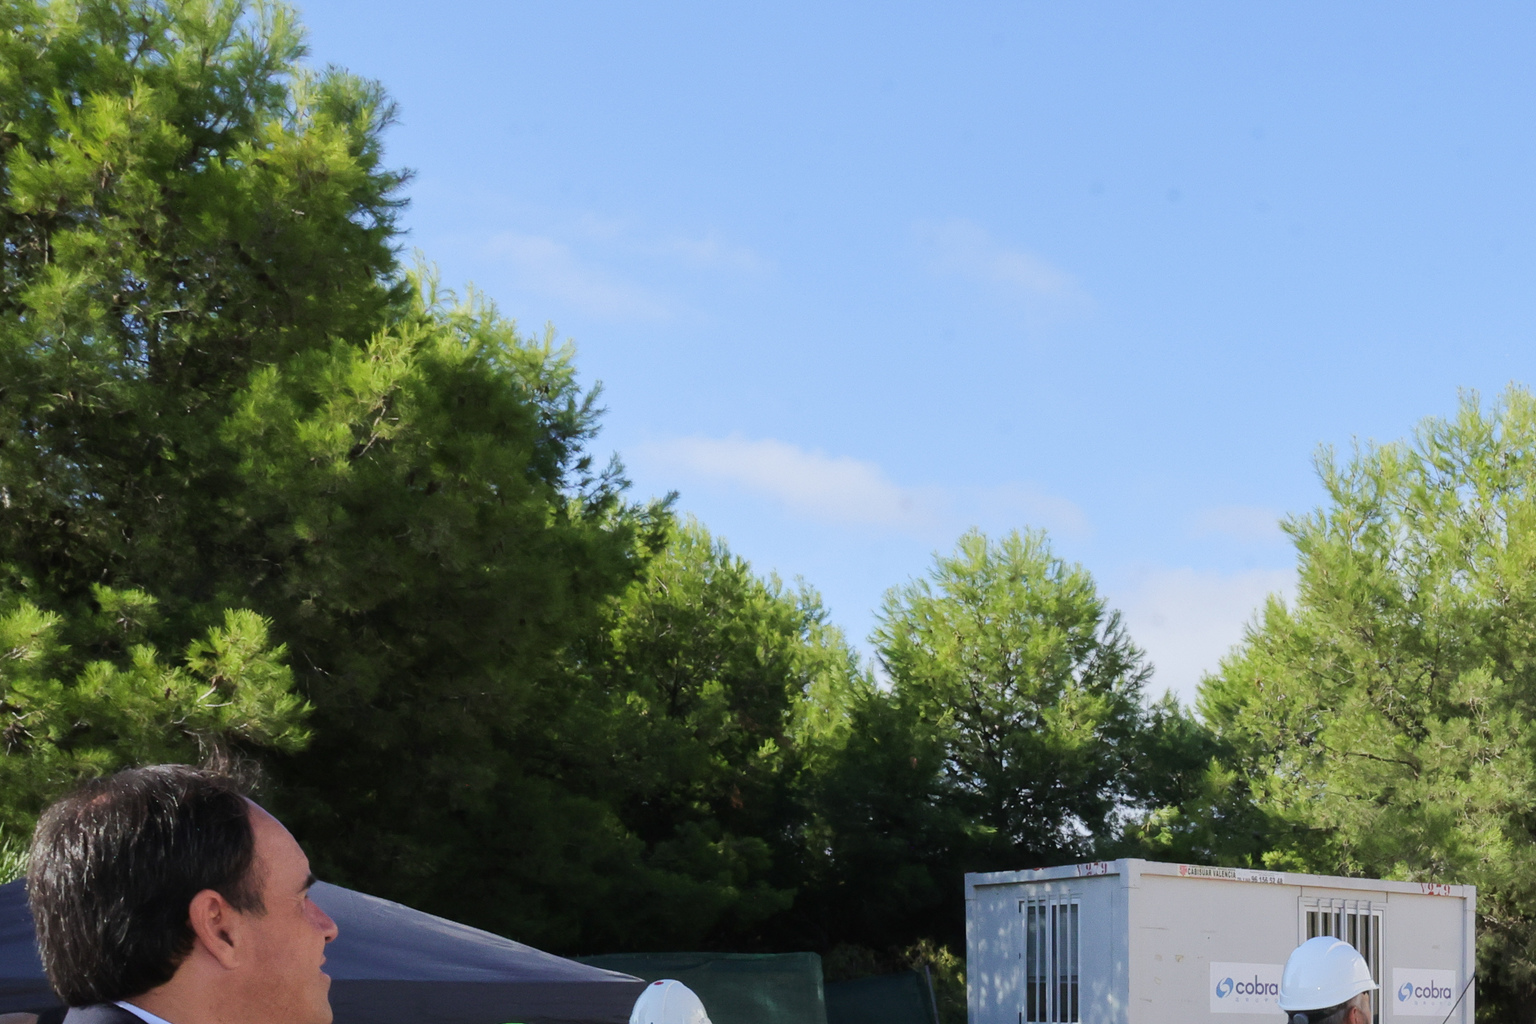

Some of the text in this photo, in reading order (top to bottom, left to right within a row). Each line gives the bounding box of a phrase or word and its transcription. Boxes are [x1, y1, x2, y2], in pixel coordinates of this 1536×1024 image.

[1213, 870, 1236, 879] VALENCIA
[1235, 974, 1279, 996] cobra
[1414, 979, 1452, 999] cobra
